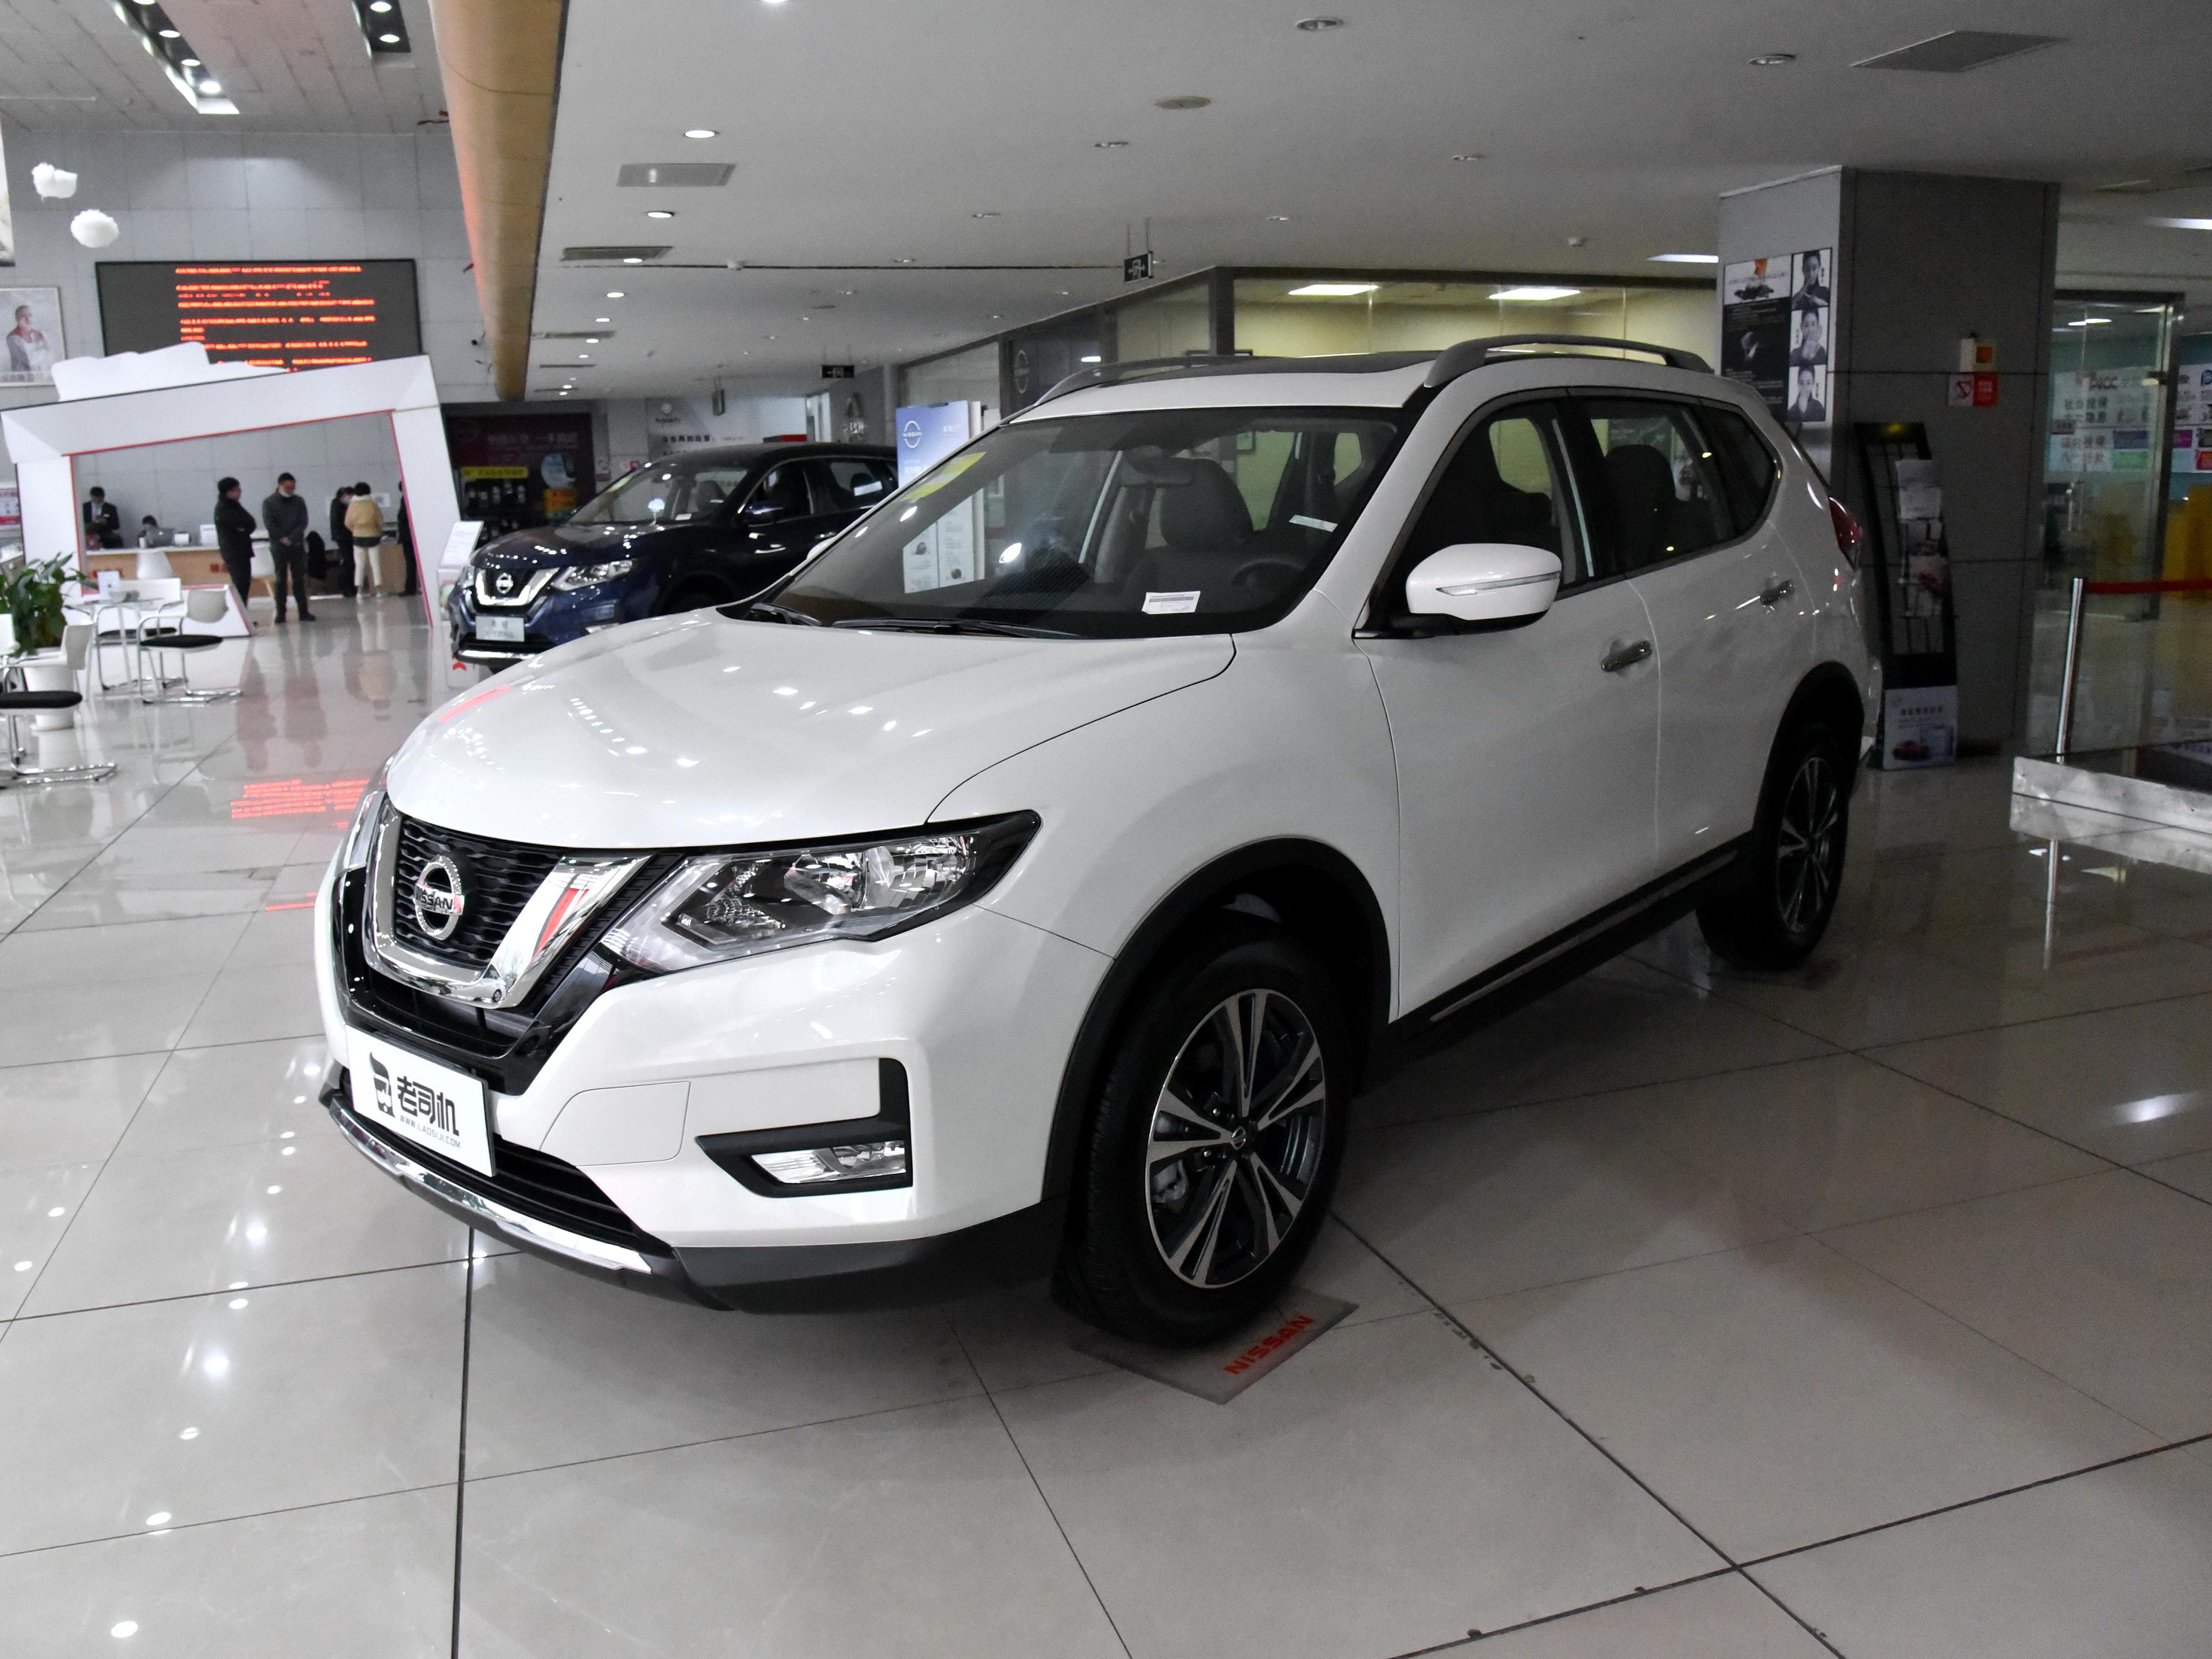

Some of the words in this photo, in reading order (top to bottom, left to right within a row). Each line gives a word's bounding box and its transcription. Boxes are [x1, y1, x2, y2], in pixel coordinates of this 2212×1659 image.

[397, 1075, 459, 1137] 老司机
[399, 1114, 461, 1149] WWW.LAOSIJI.COM
[1223, 1314, 1315, 1376] NISSAN
